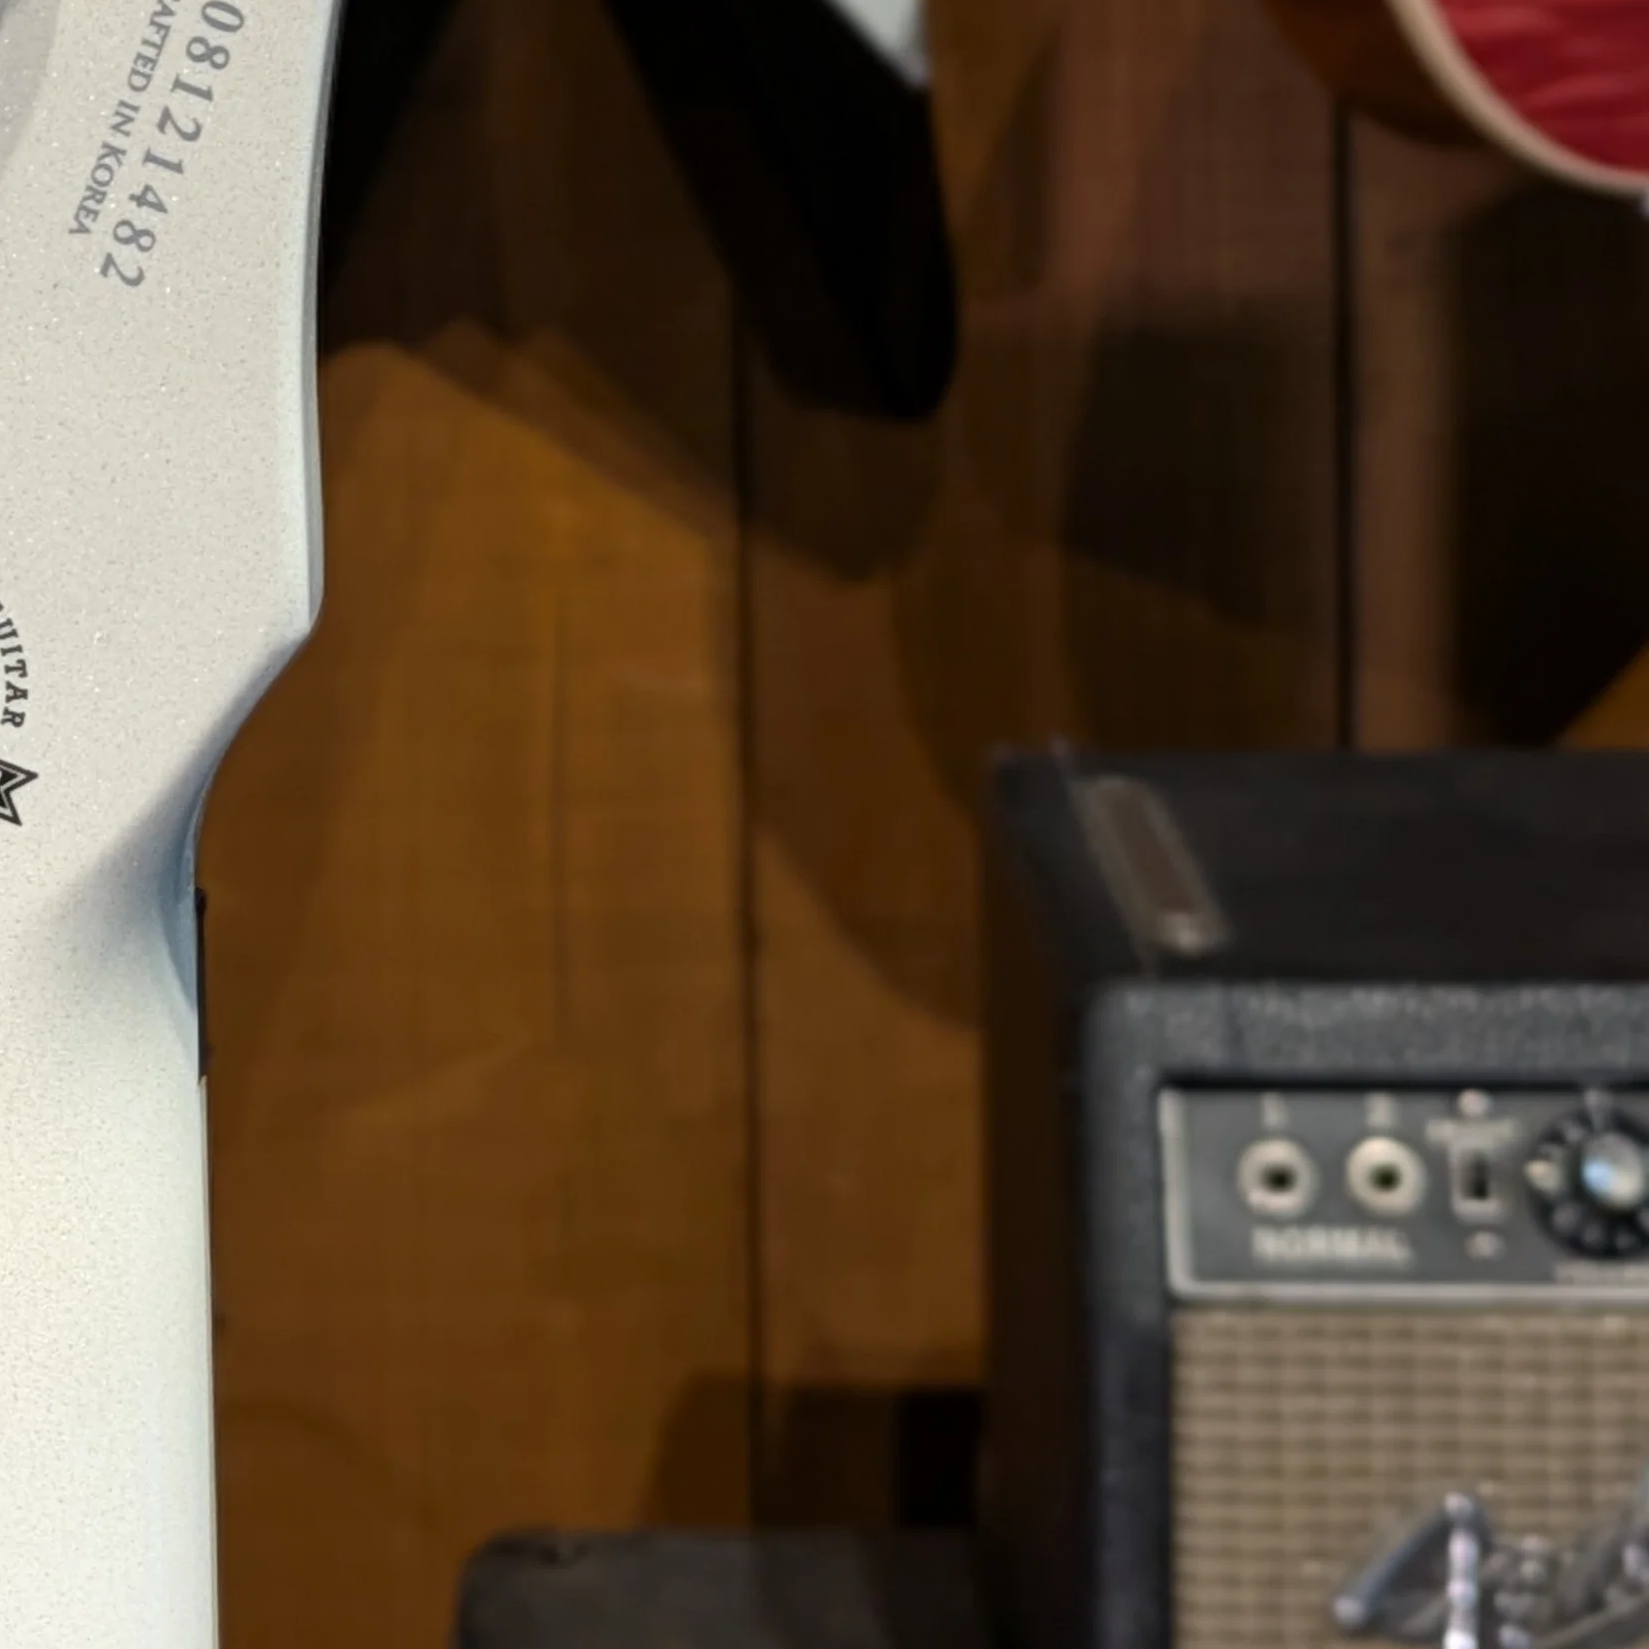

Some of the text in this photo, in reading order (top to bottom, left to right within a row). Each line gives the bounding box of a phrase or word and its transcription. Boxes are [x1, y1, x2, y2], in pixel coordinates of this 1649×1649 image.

[109, 98, 141, 139] IN
[67, 142, 128, 237] KOREA
[1251, 1224, 1415, 1270] NORMAL
